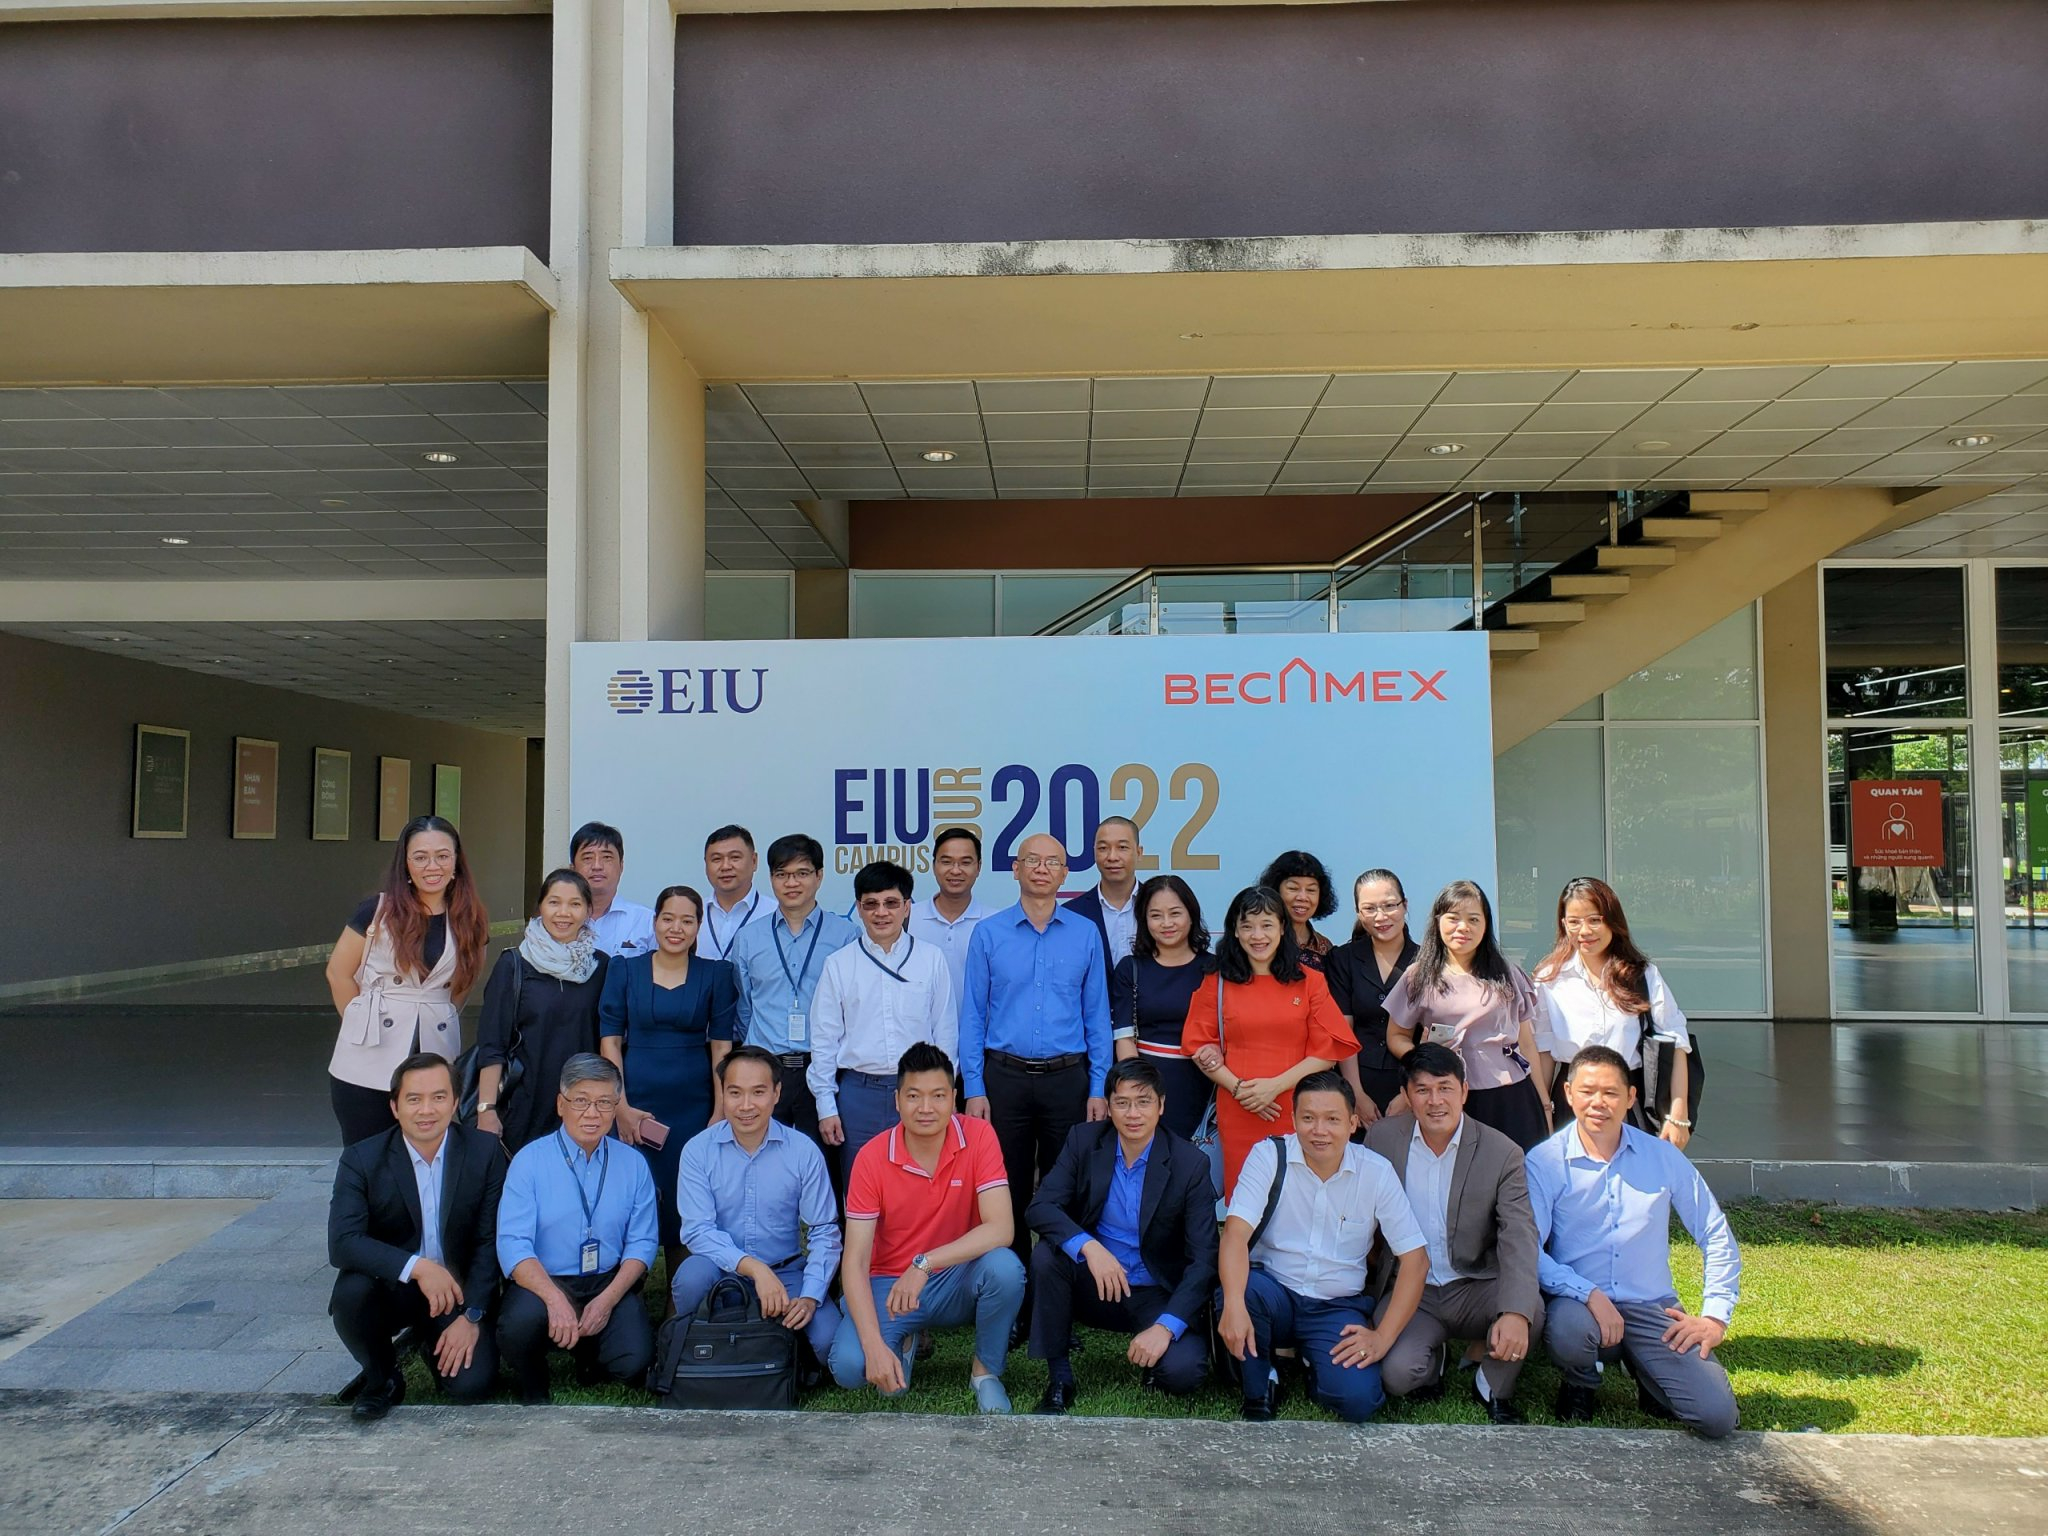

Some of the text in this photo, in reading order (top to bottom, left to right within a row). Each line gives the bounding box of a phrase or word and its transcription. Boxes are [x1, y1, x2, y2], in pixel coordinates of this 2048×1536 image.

[657, 668, 769, 714] EIU
[1164, 656, 1448, 705] BECAMEX
[834, 767, 930, 845] EIU
[1870, 786, 1923, 797] QUAN TÂM
[991, 762, 1221, 872] 2022
[834, 844, 930, 875] CAMPUS
